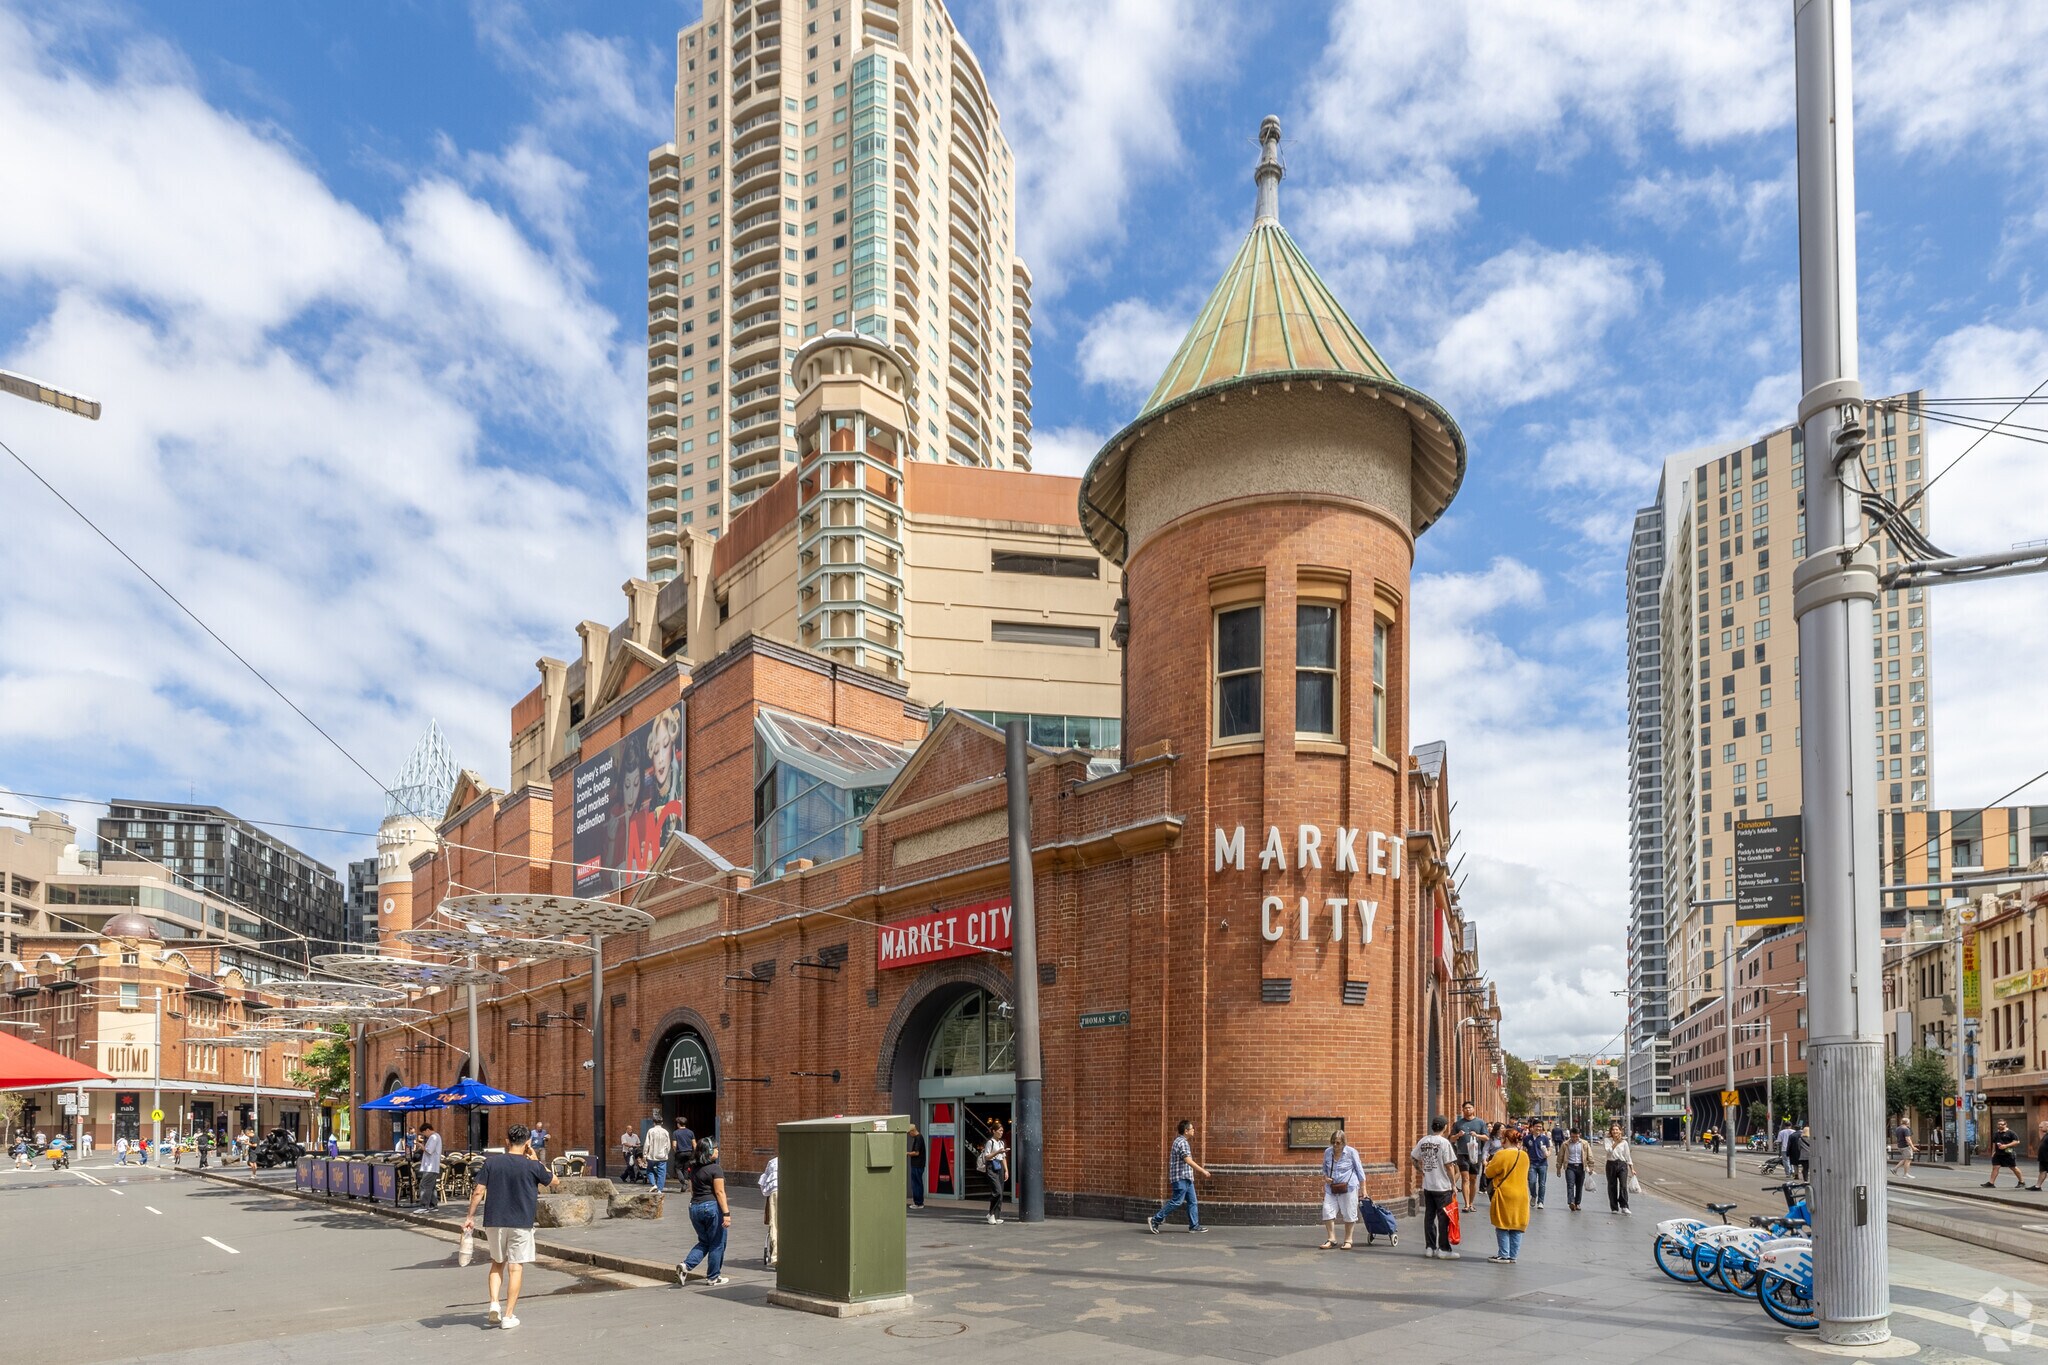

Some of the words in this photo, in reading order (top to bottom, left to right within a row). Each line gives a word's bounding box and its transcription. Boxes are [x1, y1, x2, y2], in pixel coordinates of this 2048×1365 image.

[576, 767, 598, 789] Sydney's
[599, 757, 613, 774] most
[576, 787, 592, 804] iconic
[593, 776, 611, 794] foodie
[576, 804, 588, 819] and
[588, 793, 609, 812] markets
[576, 812, 606, 834] destination
[1737, 820, 1771, 829] Chinatown
[1215, 824, 1404, 880] MARKET
[1262, 896, 1378, 944] CITY
[881, 917, 957, 961] MARKET
[967, 905, 1012, 945] CITY
[1081, 1016, 1106, 1025] THOMAS
[108, 1047, 148, 1072] ULTIMO
[673, 1057, 693, 1078] HAY
[437, 1093, 467, 1102] Tiger
[352, 1168, 364, 1191] Tiger
[378, 1169, 392, 1194] Tiger
